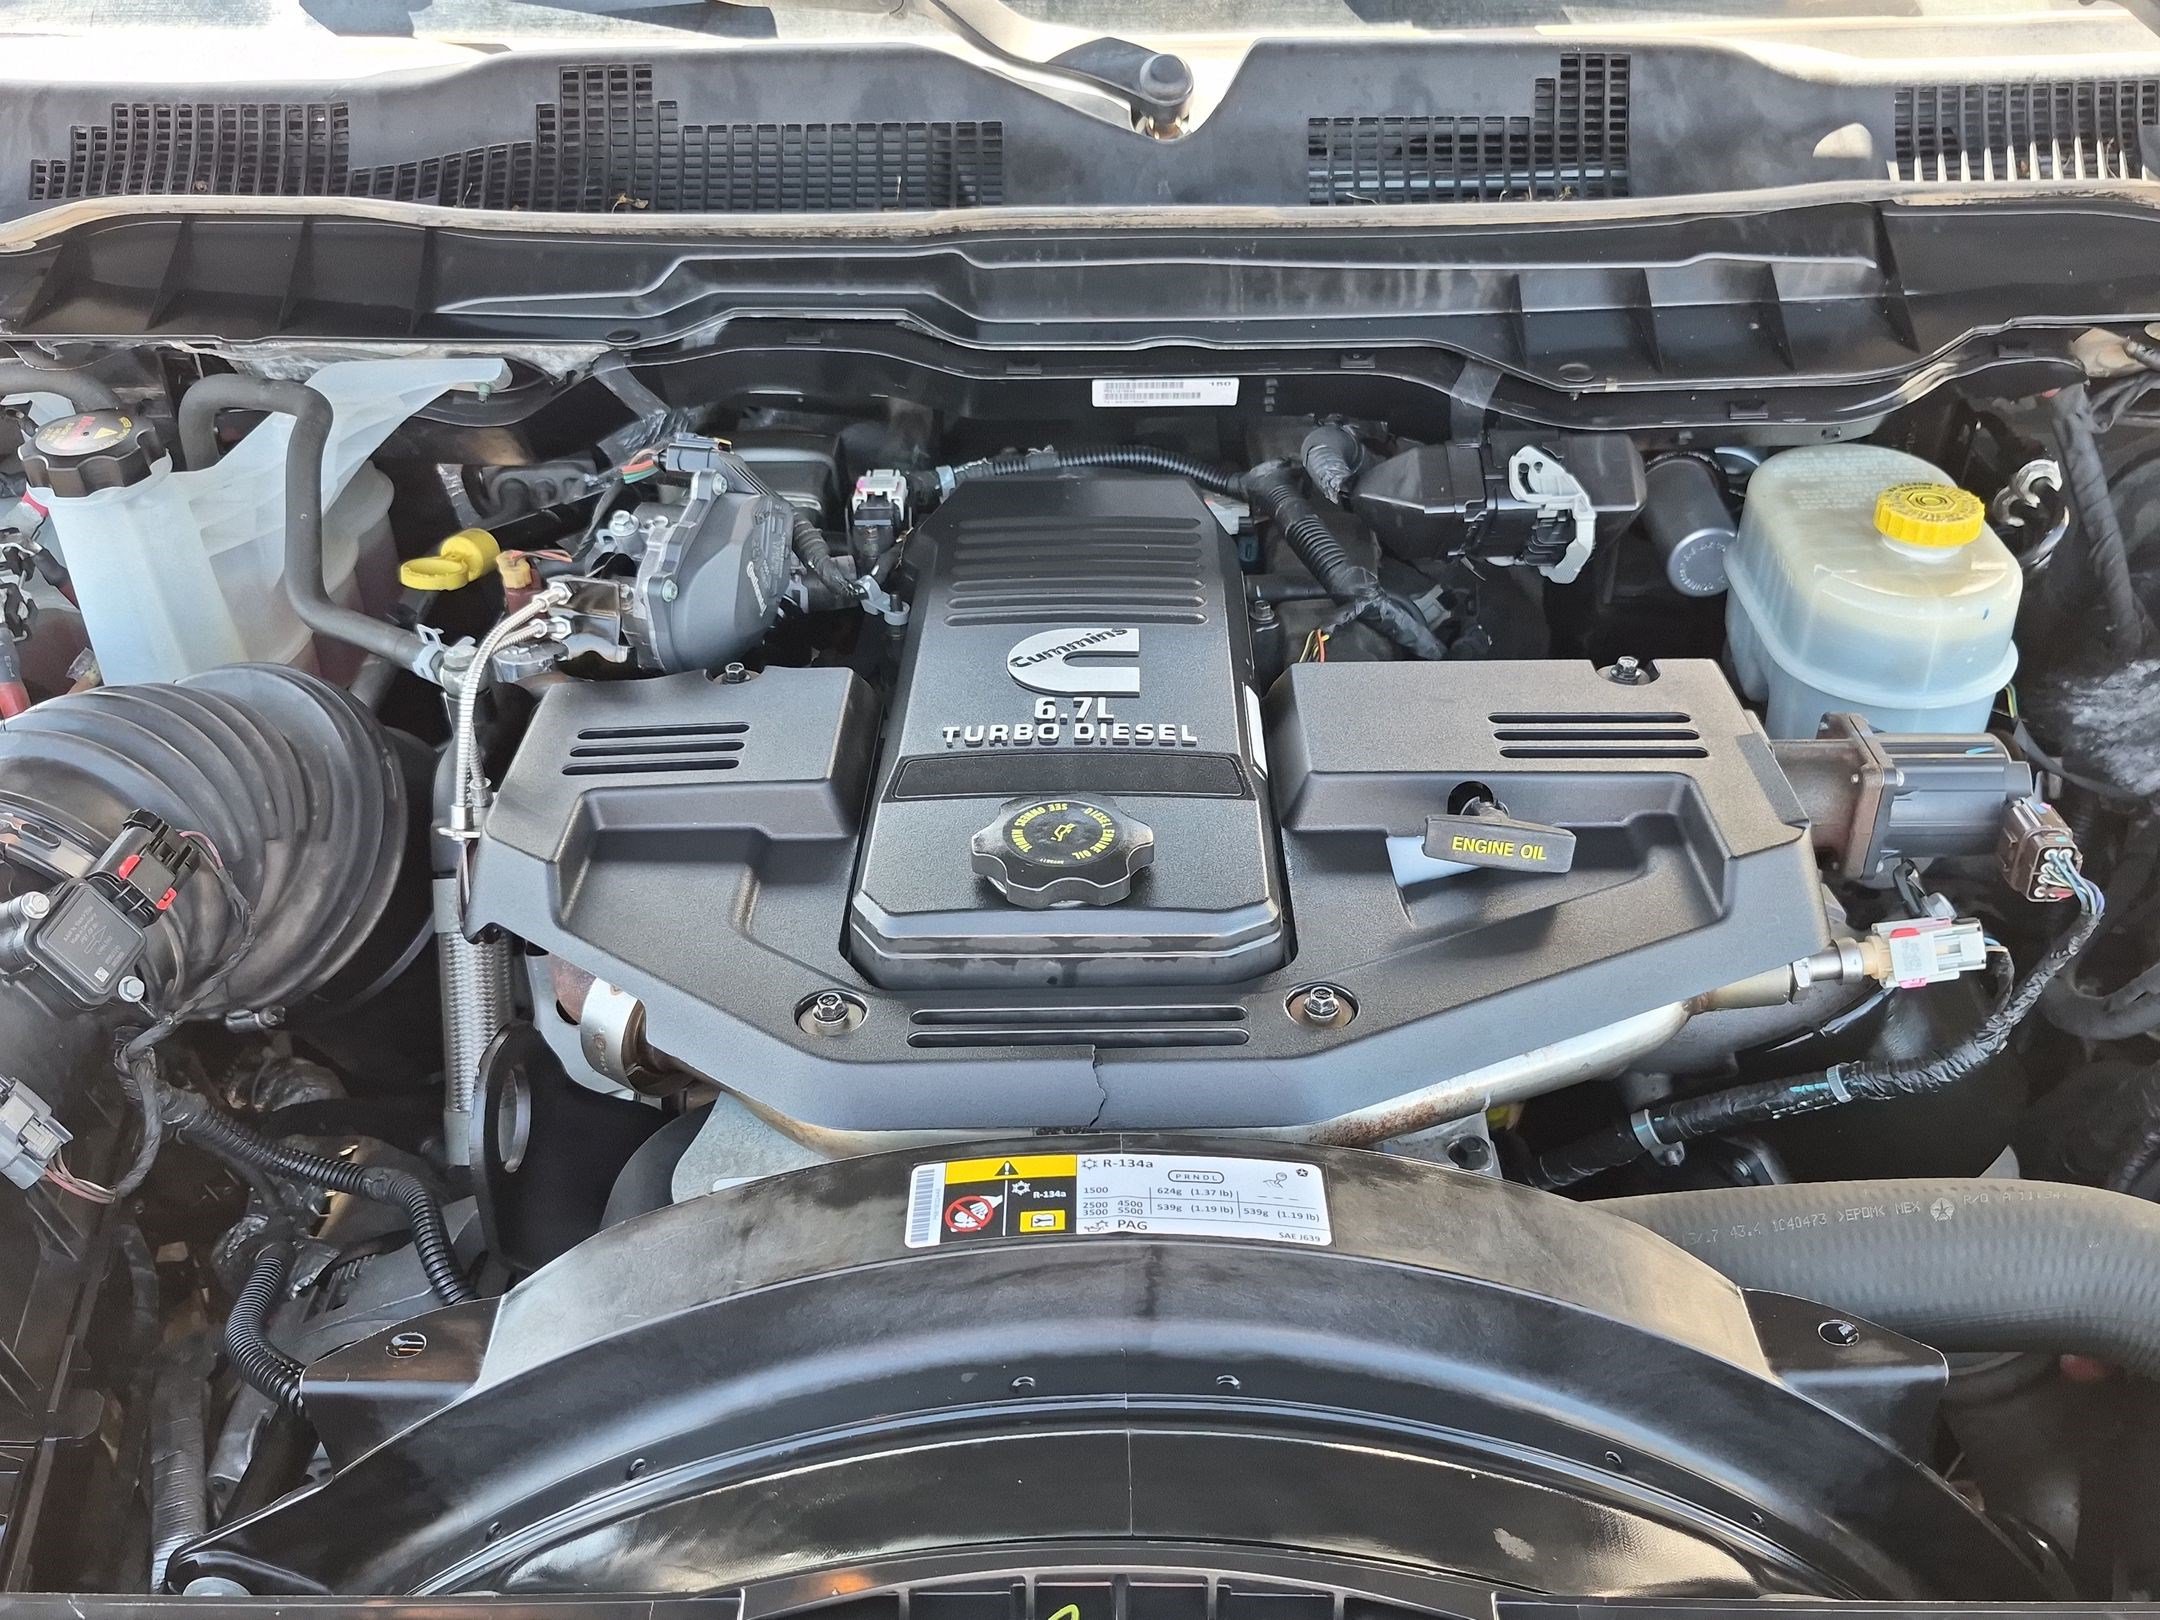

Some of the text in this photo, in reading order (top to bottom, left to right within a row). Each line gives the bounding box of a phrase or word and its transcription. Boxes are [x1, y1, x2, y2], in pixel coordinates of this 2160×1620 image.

[1010, 628, 1128, 668] Cummins
[1034, 697, 1115, 723] 6.7L
[943, 723, 1198, 746] TURBO DIESEL
[1047, 803, 1068, 812] SEE
[1084, 807, 1113, 828] DIESEL
[1452, 836, 1547, 861] ENGINE OIL
[1072, 849, 1092, 860] OIL
[1102, 1159, 1154, 1168] R-134a
[1033, 1190, 1067, 1199] R-134a
[1157, 1188, 1233, 1198] 624g (1.37 lb)
[1118, 1200, 1143, 1208] 4500
[1157, 1204, 1234, 1215] 539g (1.19 lb)
[1895, 1201, 1921, 1215] MEX
[1118, 1207, 1143, 1215] 5500
[1243, 1208, 1320, 1222] 539g (1.19 lb)
[1117, 1220, 1148, 1231] PAG
[1279, 1232, 1321, 1242] SAE J639
